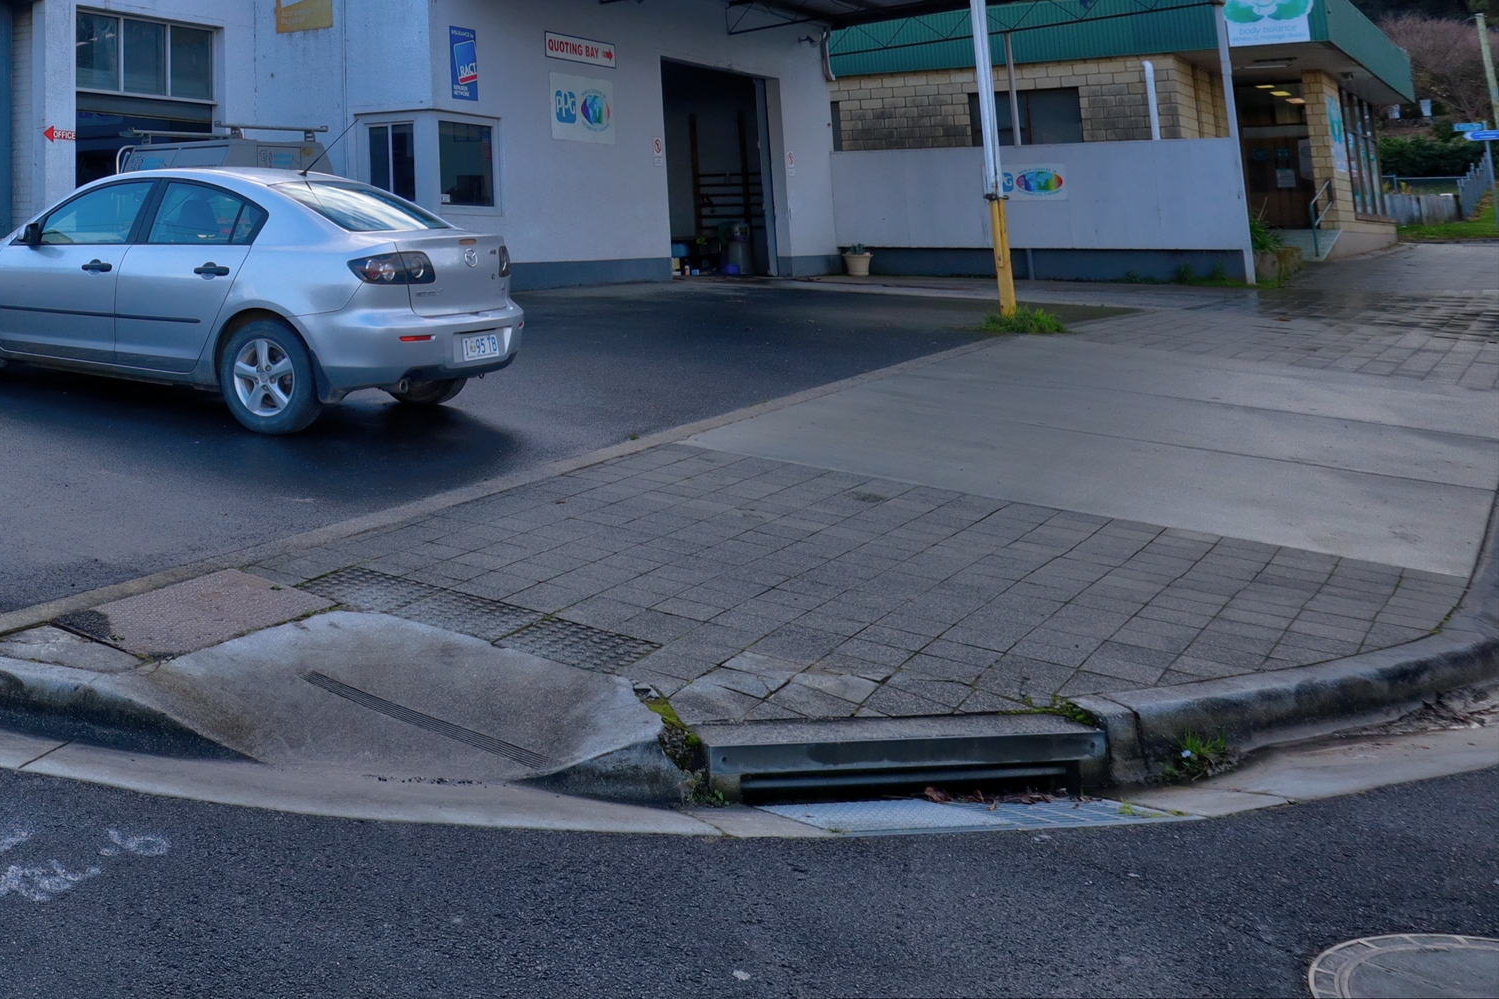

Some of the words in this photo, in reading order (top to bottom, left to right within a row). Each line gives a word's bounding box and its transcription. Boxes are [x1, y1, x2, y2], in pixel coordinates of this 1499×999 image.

[548, 39, 583, 56] QUOTING
[585, 45, 600, 59] BAY
[459, 62, 477, 77] RACT
[556, 91, 576, 117] PPG
[53, 130, 76, 140] OFFICE
[475, 338, 486, 353] 95
[487, 337, 497, 352] TB
